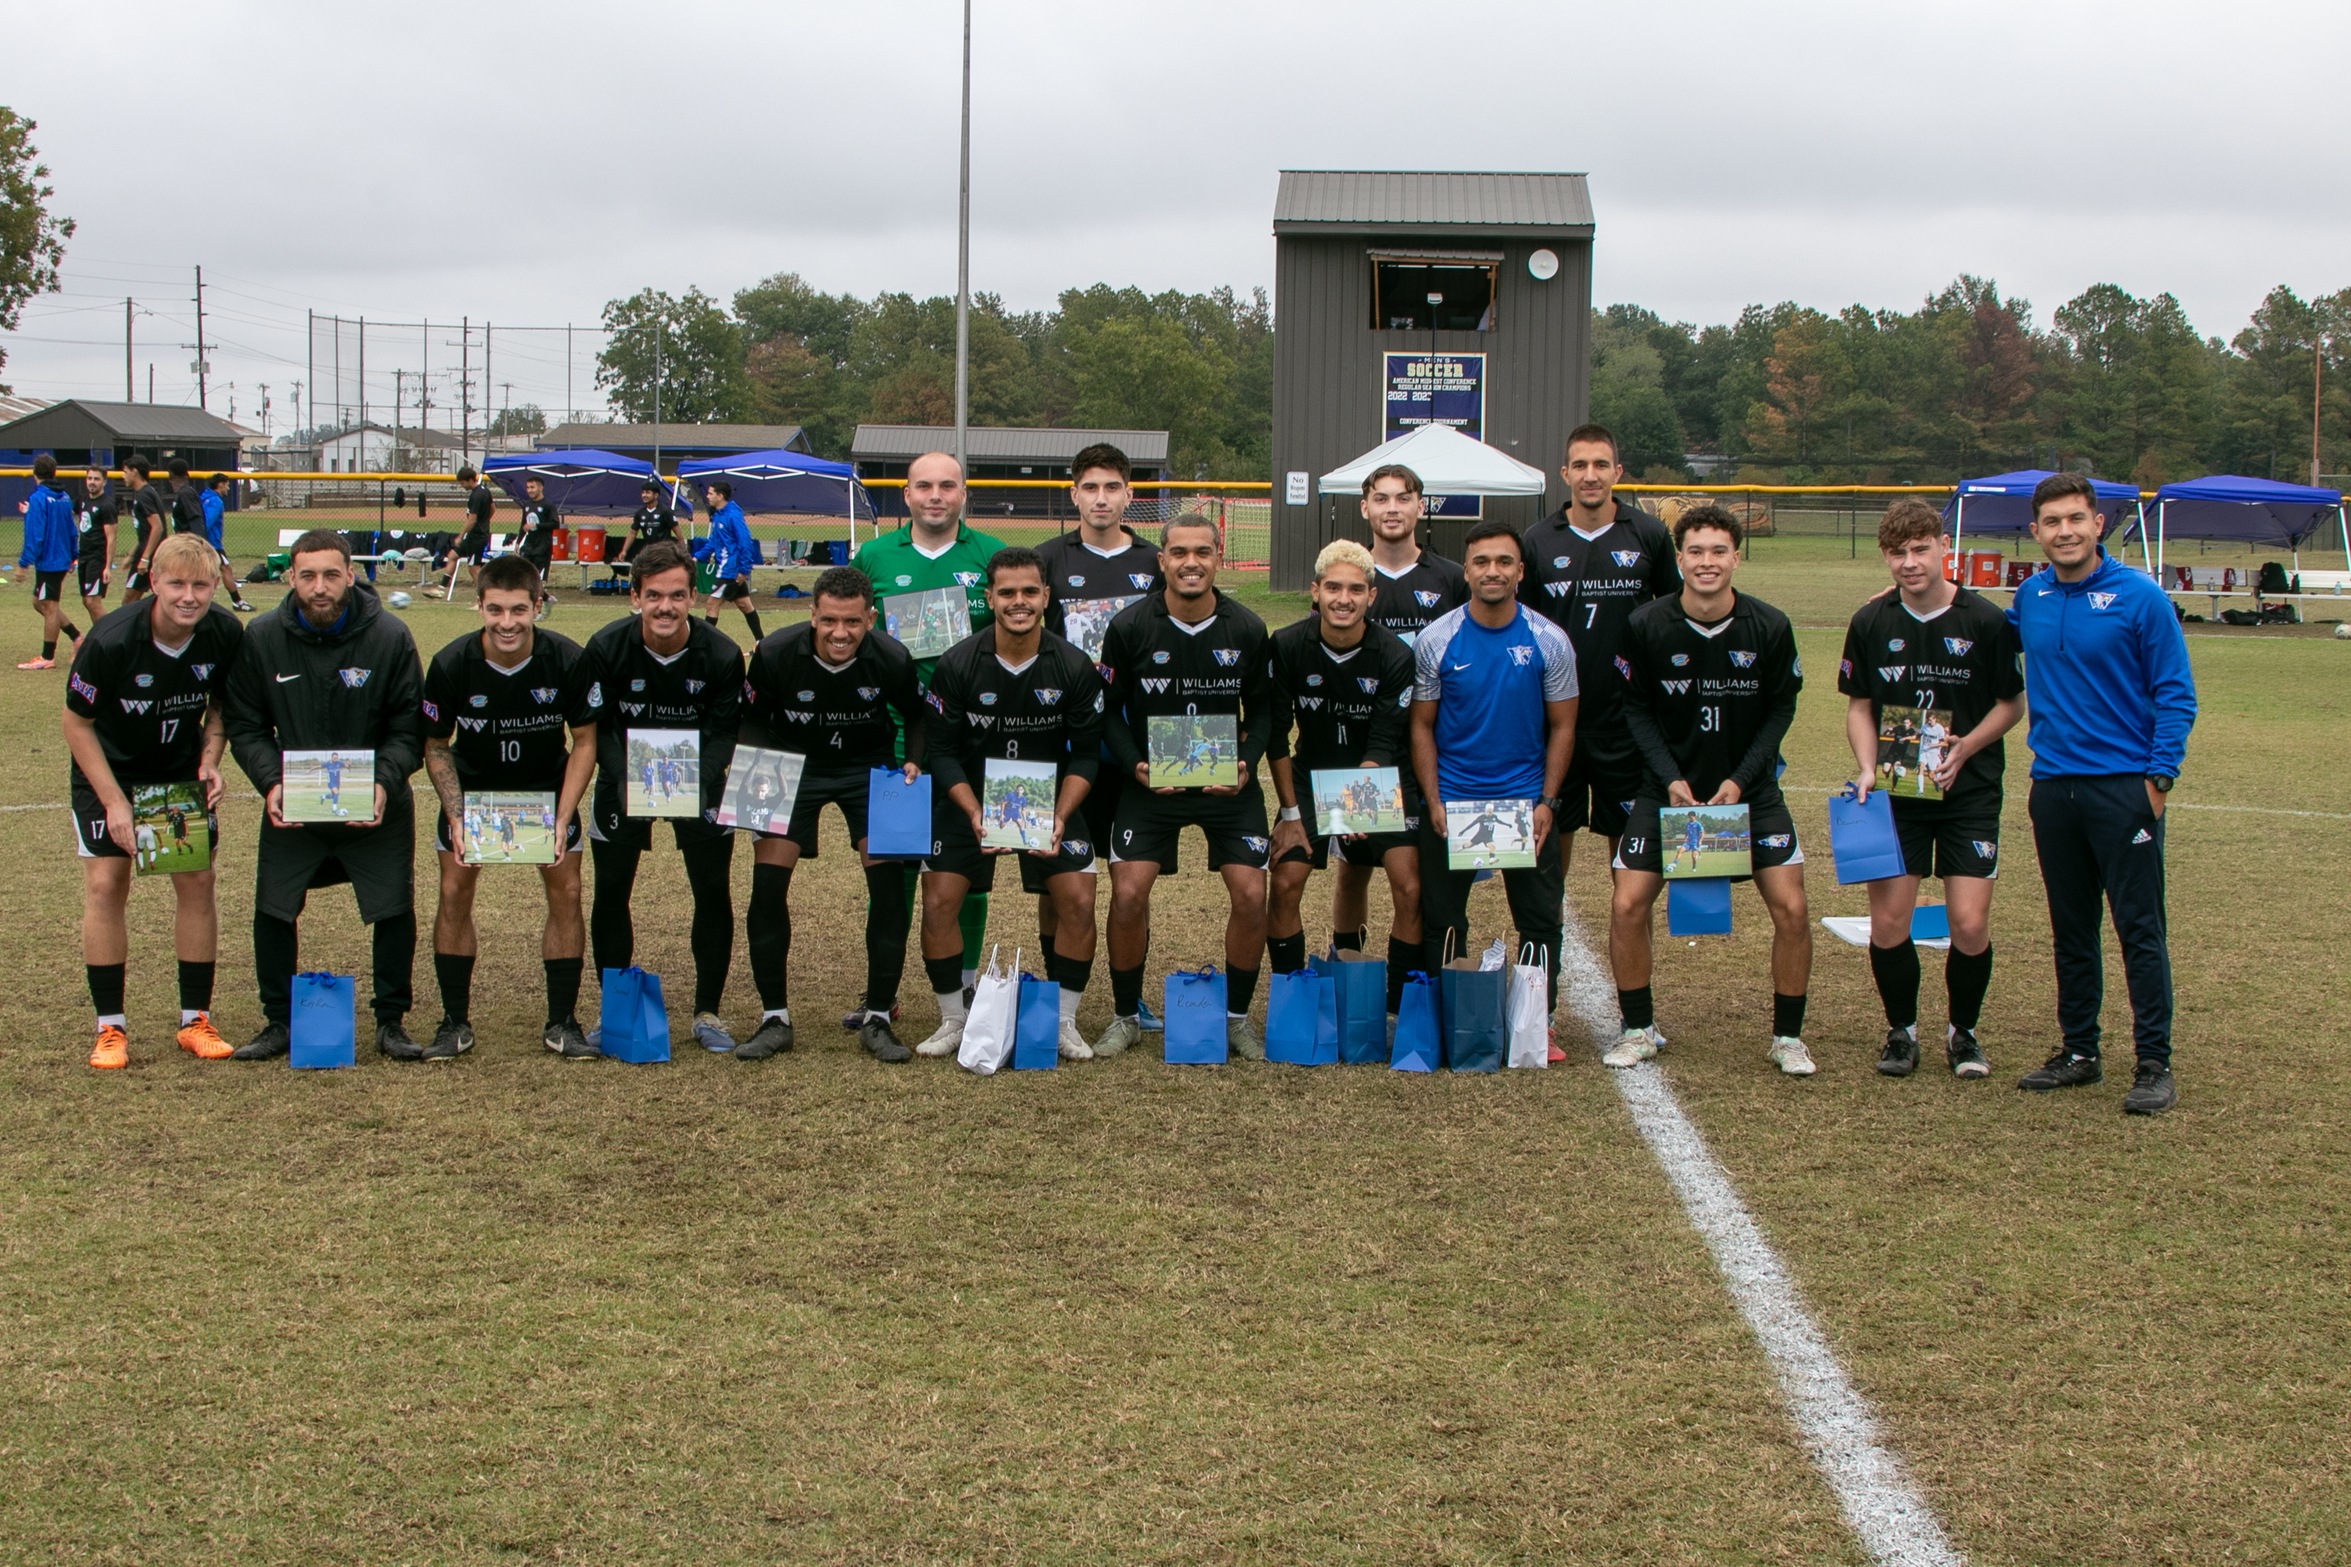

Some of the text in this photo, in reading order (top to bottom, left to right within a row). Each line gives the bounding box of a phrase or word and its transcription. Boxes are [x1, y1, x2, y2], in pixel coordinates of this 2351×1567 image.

[1407, 363, 1463, 377] SOCCER
[1387, 391, 1408, 401] 2022
[2017, 569, 2025, 580] 5
[1582, 579, 1642, 589] WILLIAMS
[1585, 603, 1598, 630] 7
[1917, 665, 1971, 679] WILLIAMS
[1182, 678, 1241, 689] WILLIAMS
[1702, 678, 1759, 690] WILLIAMS
[1916, 689, 1935, 709] 22
[500, 713, 563, 729] WILLIAMS
[1004, 714, 1063, 727] WILLIAMS
[1700, 706, 1720, 732] 31
[161, 718, 180, 744] 17
[526, 723, 563, 733] UNIVERSITY
[1337, 721, 1348, 746] 11
[829, 731, 842, 749] 4
[500, 740, 521, 763] 10
[1006, 739, 1018, 760] 8
[91, 819, 106, 840] 17
[610, 813, 618, 830] 3
[1123, 829, 1133, 846] 9
[1628, 837, 1645, 854] 31
[933, 840, 942, 856] 8
